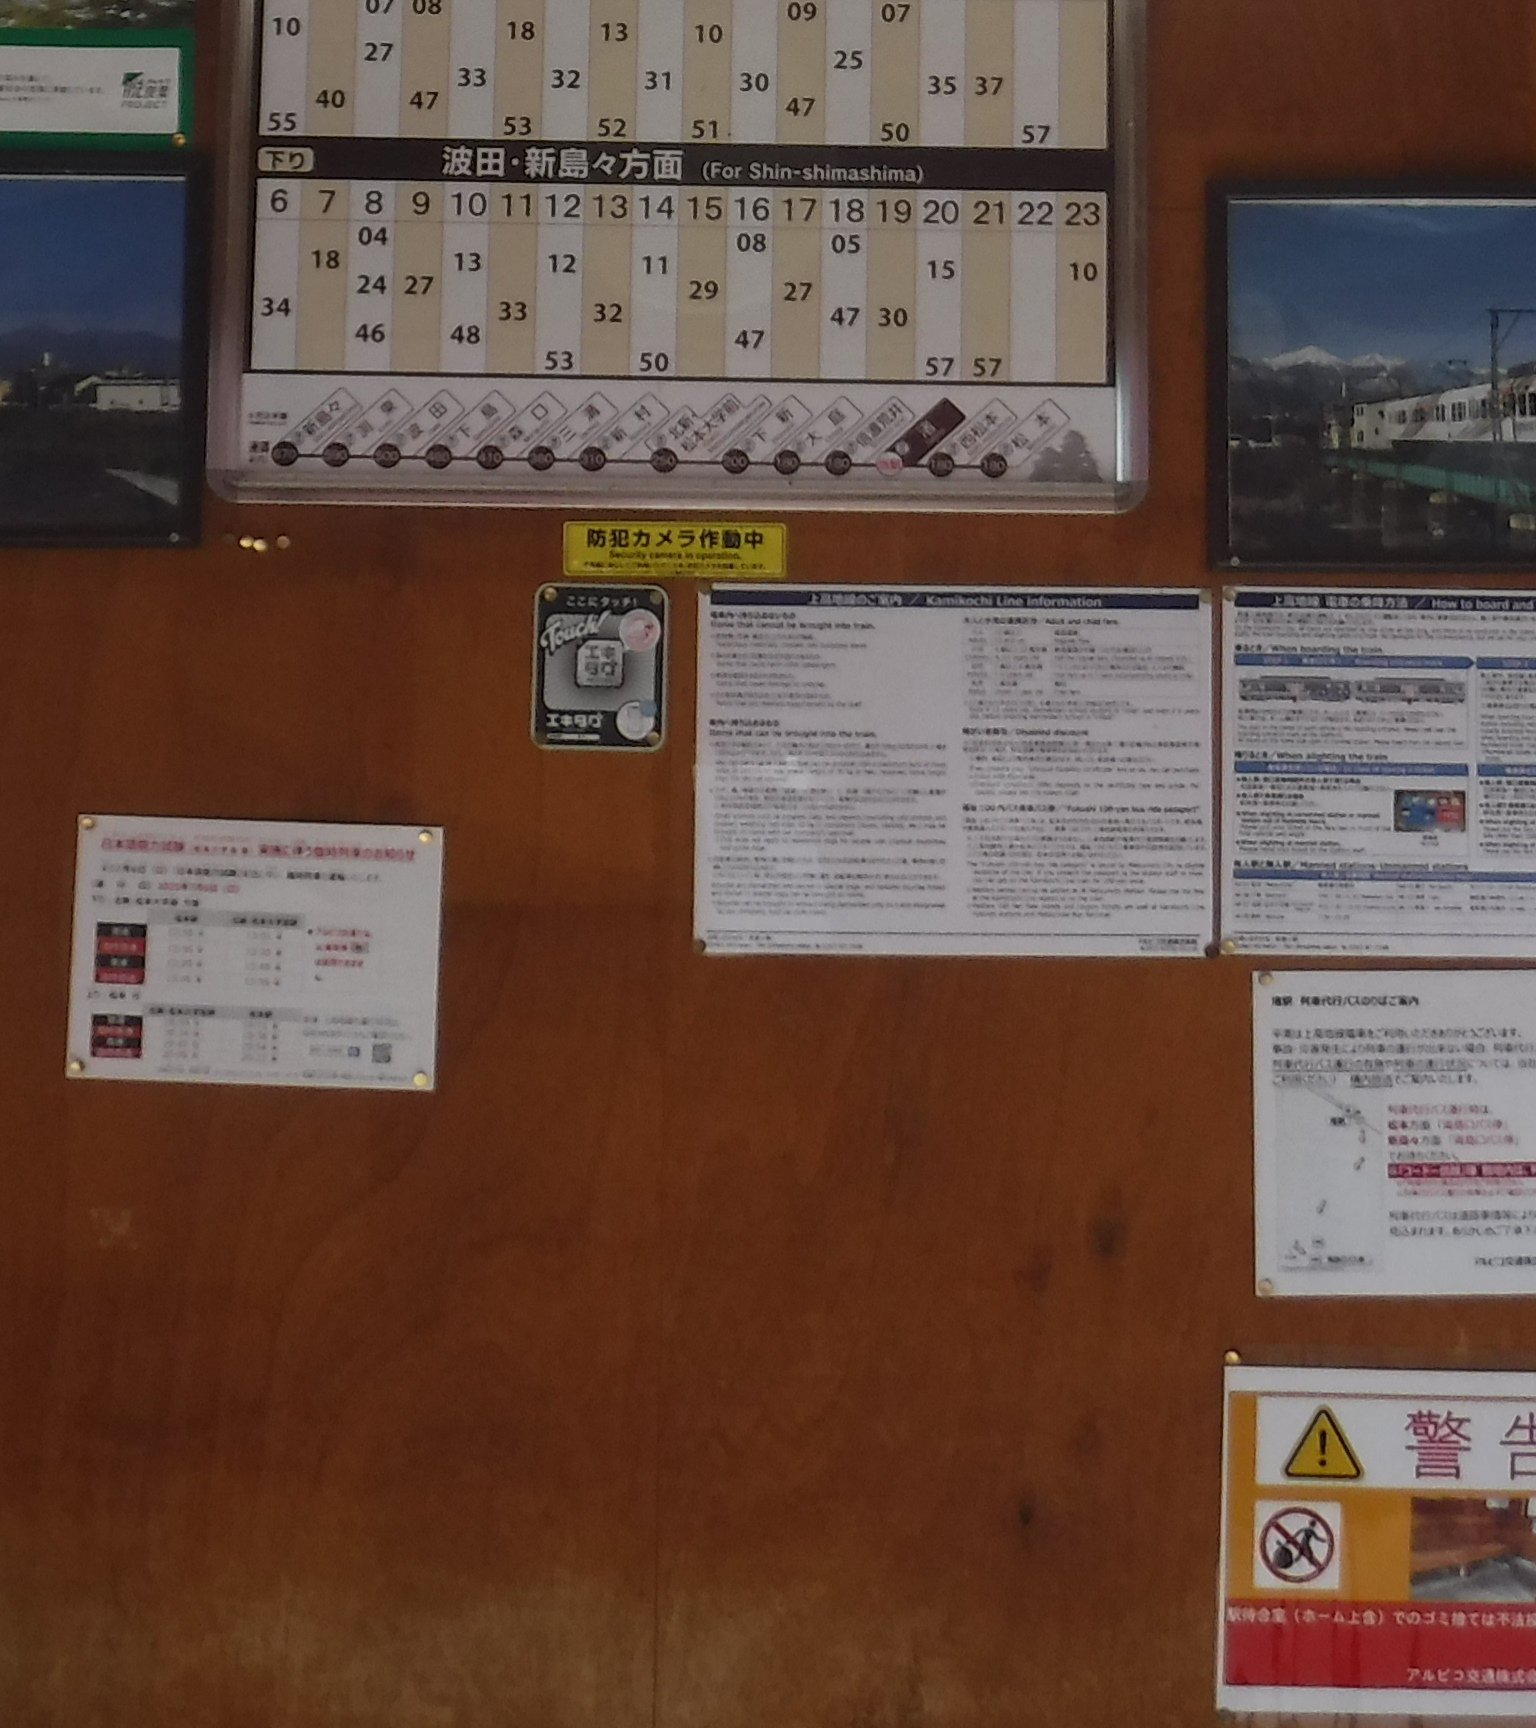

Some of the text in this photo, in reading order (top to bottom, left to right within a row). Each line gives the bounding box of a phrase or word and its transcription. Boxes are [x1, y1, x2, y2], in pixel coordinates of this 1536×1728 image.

[787, 1, 817, 22] 09
[881, 3, 911, 23] 07
[272, 17, 723, 44] 10 18 13 10
[364, 42, 863, 70] 27 25
[457, 67, 1004, 96] 33 32 31 30 35 37
[315, 89, 816, 117] 40 47 47
[267, 112, 1051, 145] 55 53 52 51 50 57
[268, 151, 306, 170] 下り
[441, 145, 683, 182] 波田・新島々方面
[701, 163, 925, 184] (For Shin-shimashima)
[270, 188, 1101, 227] 6 7 8 9 10 11 12 13 14 15 16 17 18 19 20 21 22 23
[358, 226, 861, 254] 04 08 05
[311, 249, 1098, 282] 18 13 12 11 15 10
[356, 274, 813, 302] 24 27 29 27
[260, 296, 908, 328] 34 33 32 47 30
[354, 323, 765, 350] 46 48 47
[544, 350, 1002, 378] 53 50 57 57
[586, 528, 764, 550] 防犯カメラ作動中
[925, 594, 993, 607] Kamikochi
